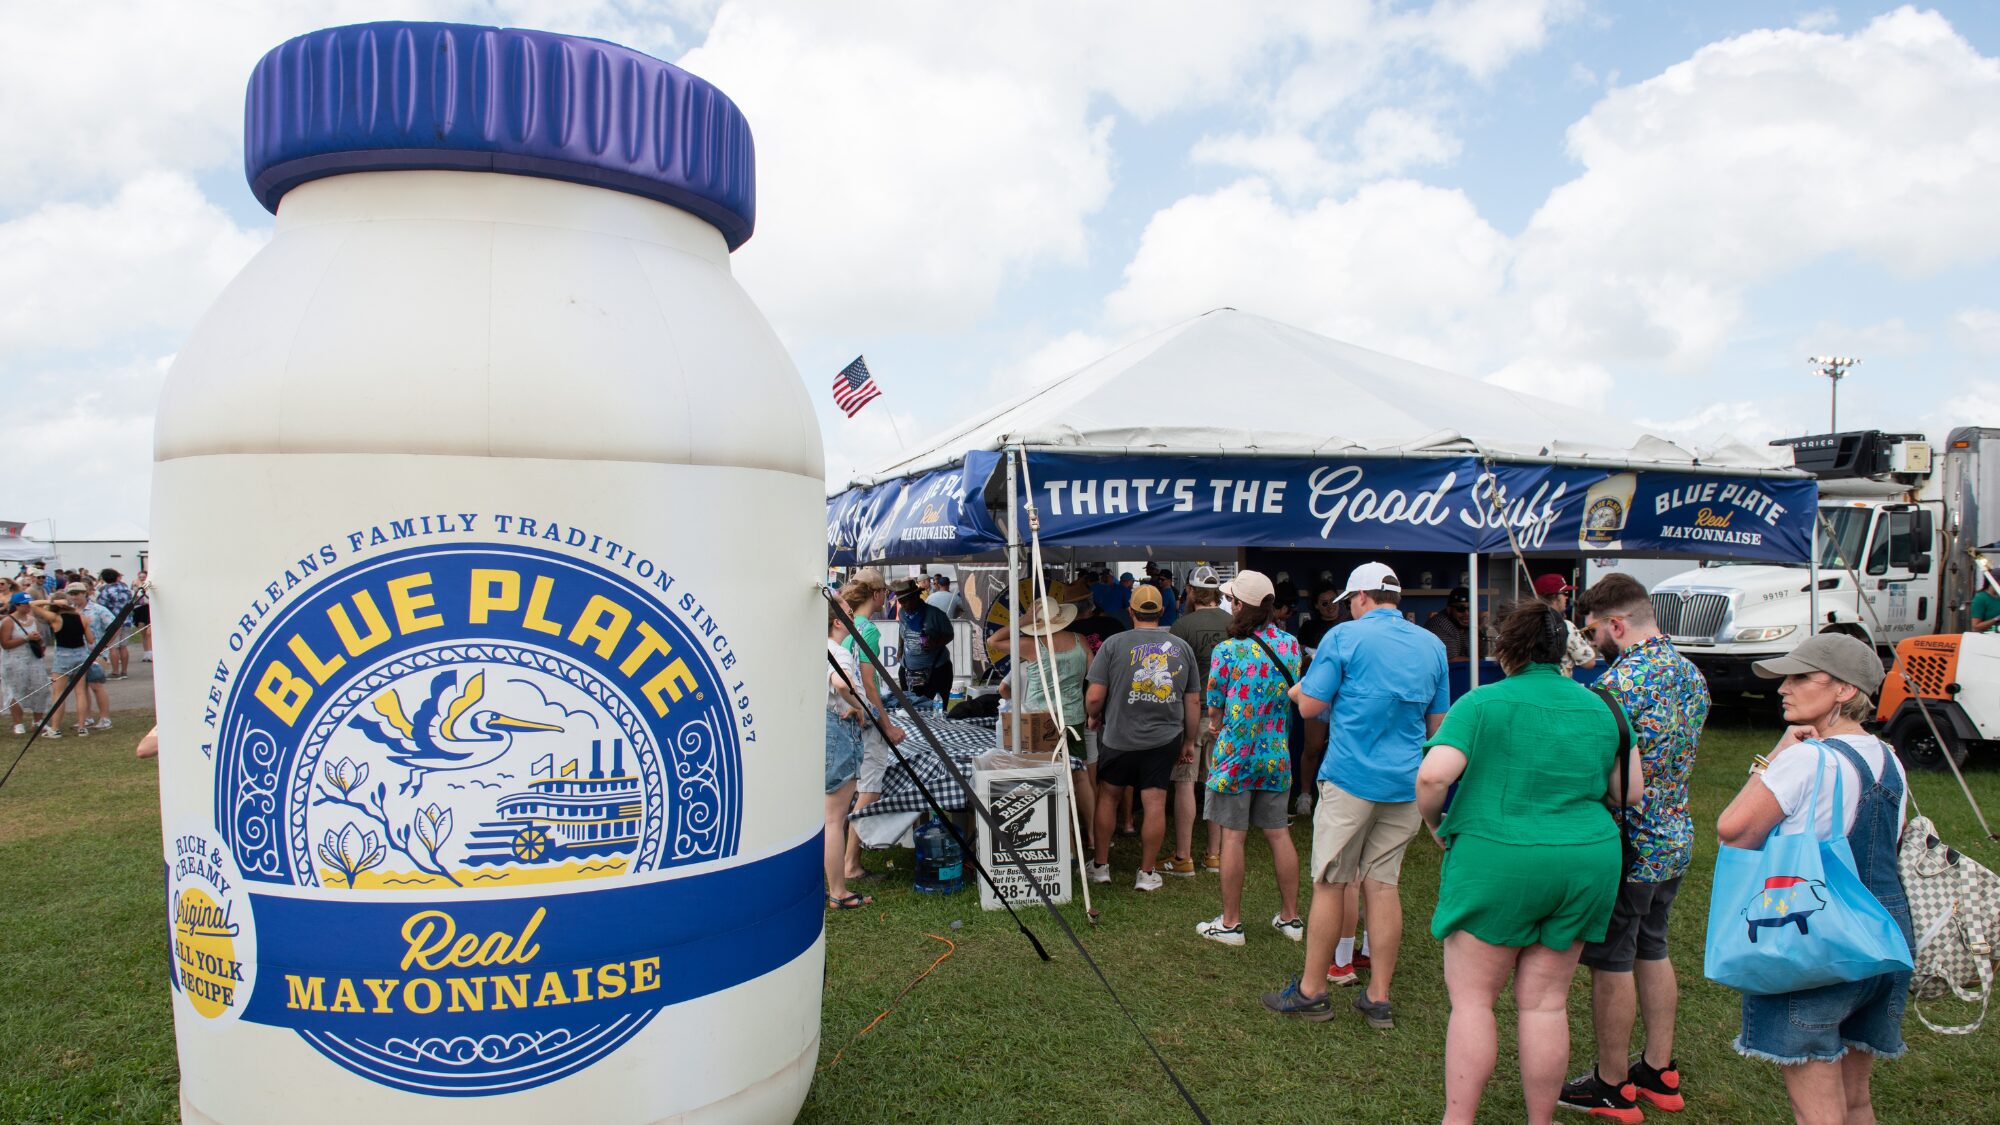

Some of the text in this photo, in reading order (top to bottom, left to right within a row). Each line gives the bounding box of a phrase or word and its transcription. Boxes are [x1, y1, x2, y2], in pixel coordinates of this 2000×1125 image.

[1043, 465, 1567, 549] THAT'S THE Good Stuff
[1655, 482, 1785, 527] BLUE PLATE
[1695, 507, 1734, 527] Real
[901, 525, 957, 541] MAYONNAISE
[1659, 525, 1762, 546] MAYONNAISE
[1763, 590, 1788, 600] 99197
[201, 513, 757, 760] A NEW ORLEANS FAMILY TRADITION SINCE 1927
[254, 568, 699, 728] BLUE PLATE
[1914, 640, 1957, 649] GENERAC
[176, 835, 223, 868] RICH &
[175, 857, 231, 897] CREAMY
[173, 890, 240, 937] Original
[175, 938, 245, 982] ALL YOLK
[400, 907, 547, 971] Real
[180, 967, 235, 1007] RECIPE
[284, 956, 661, 1014] MAYONNAISE
